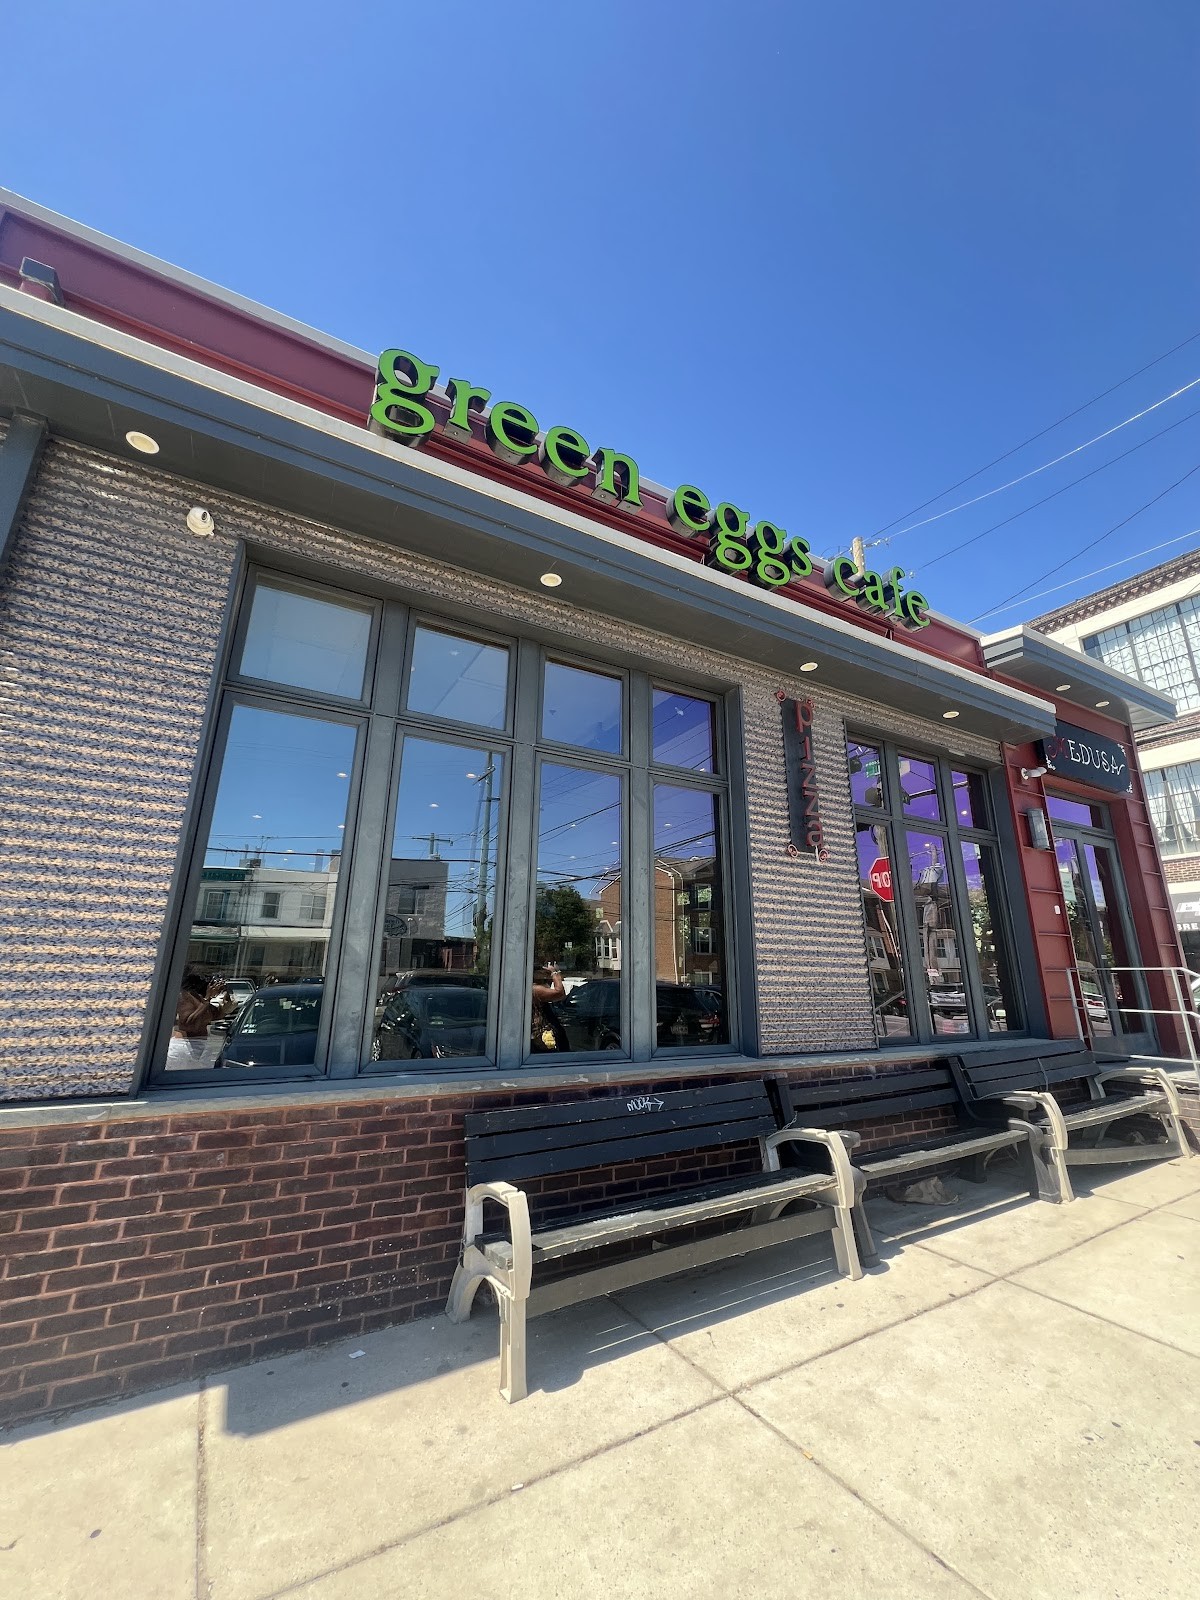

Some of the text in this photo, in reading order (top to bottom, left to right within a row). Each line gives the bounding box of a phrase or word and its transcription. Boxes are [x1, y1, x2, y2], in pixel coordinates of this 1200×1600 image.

[370, 348, 931, 627] green eggs cafe
[796, 700, 823, 847] pizza
[1048, 736, 1125, 775] MEDUSA
